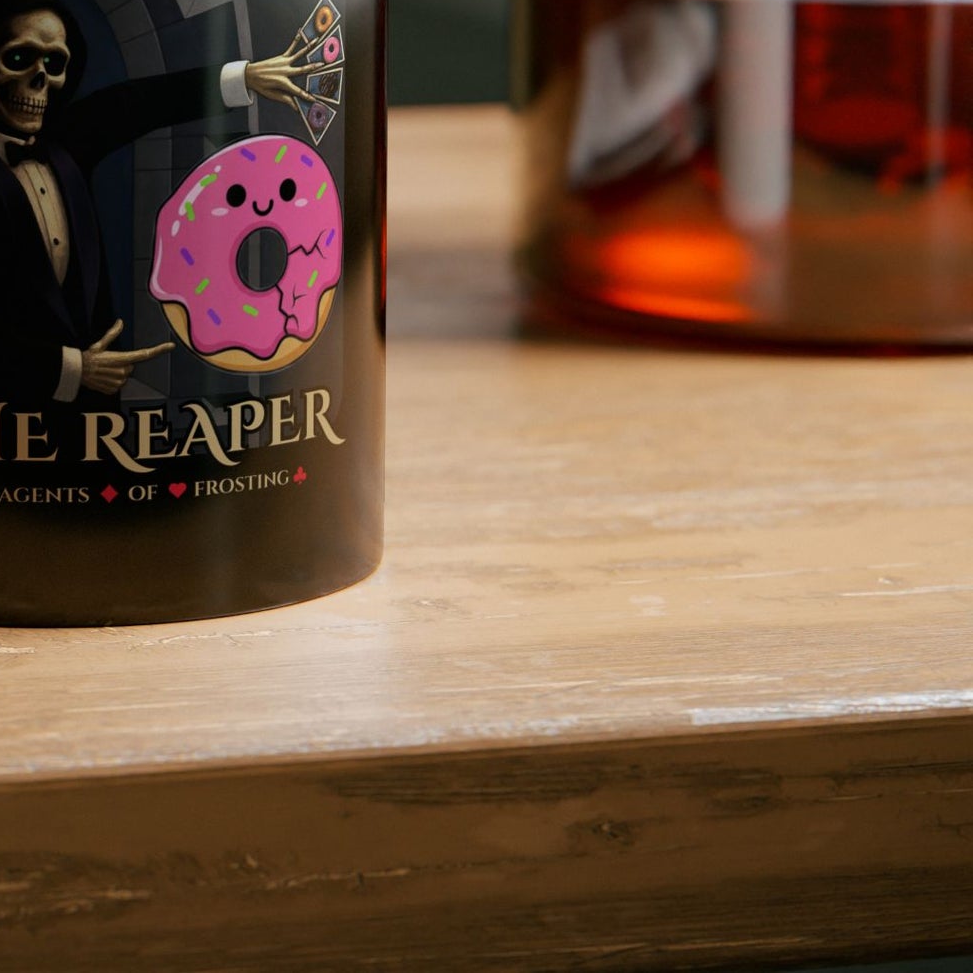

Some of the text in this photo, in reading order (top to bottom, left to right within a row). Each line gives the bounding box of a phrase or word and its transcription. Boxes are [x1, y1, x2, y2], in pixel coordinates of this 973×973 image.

[80, 388, 347, 474] REAPER
[128, 485, 158, 501] OF
[194, 469, 290, 498] FROSTING
